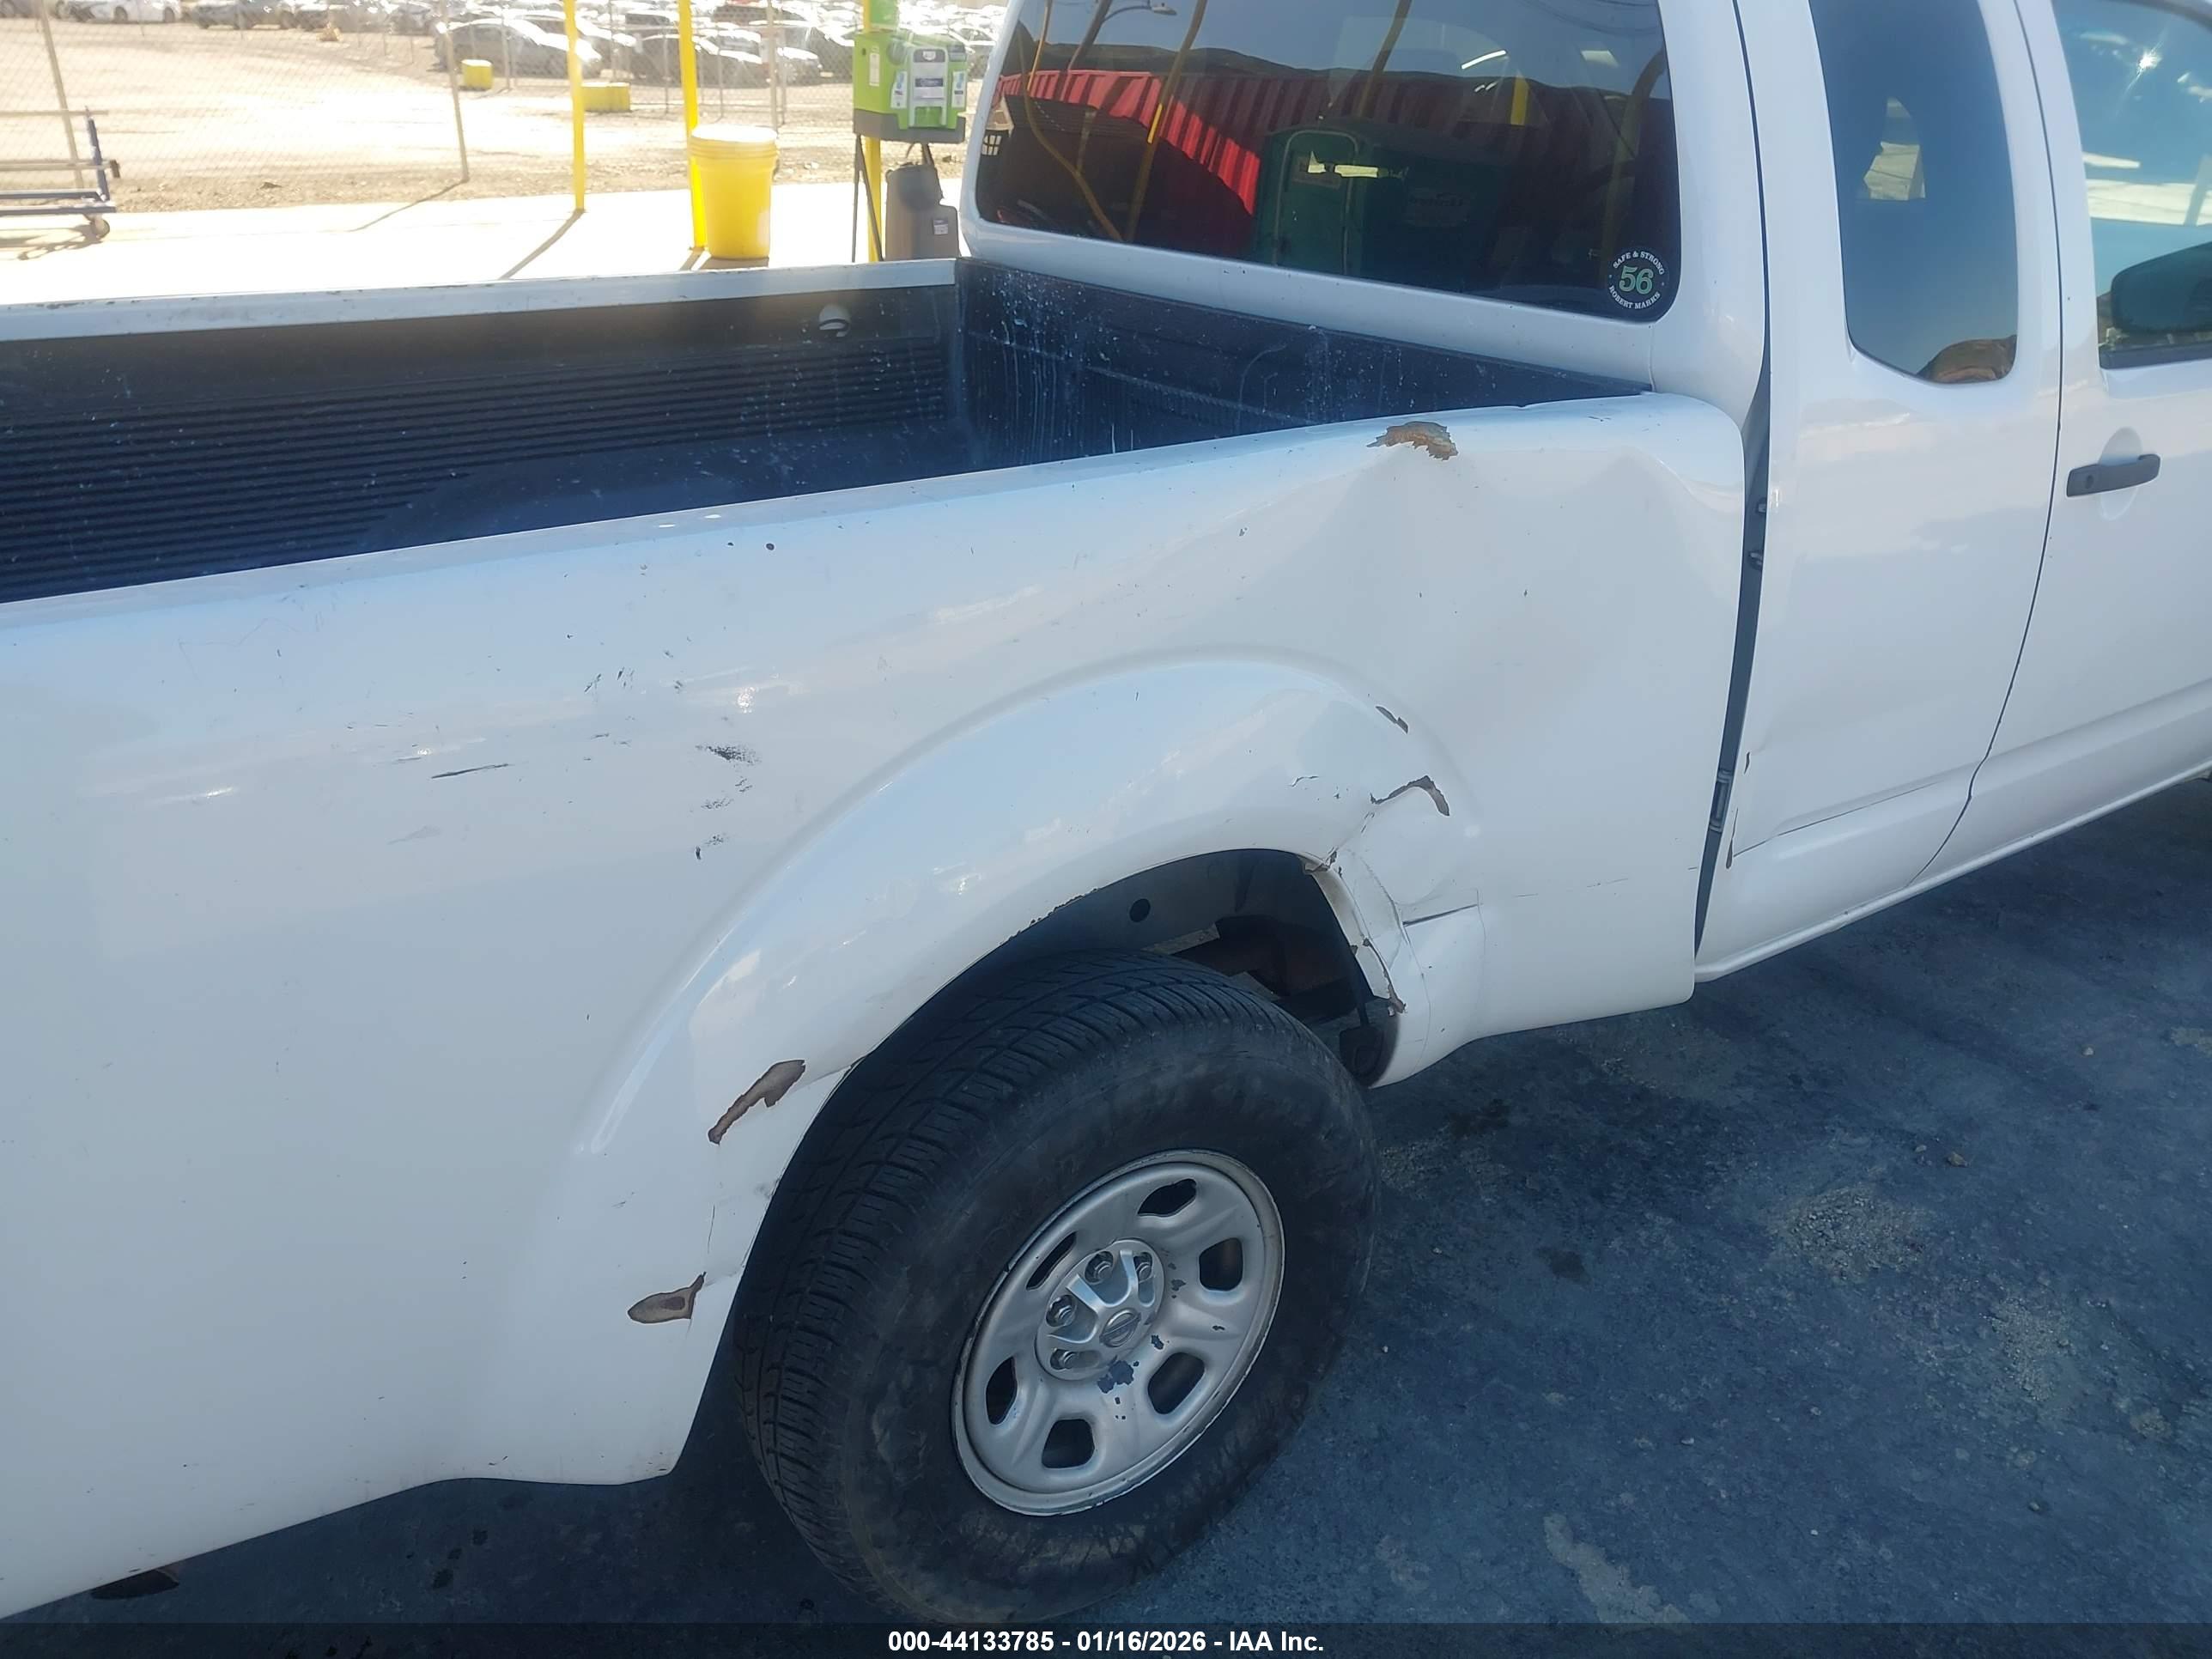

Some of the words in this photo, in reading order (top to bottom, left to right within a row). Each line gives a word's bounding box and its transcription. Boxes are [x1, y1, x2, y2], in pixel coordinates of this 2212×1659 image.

[1613, 252, 1632, 269] SAFE
[1639, 251, 1665, 275] STRONG
[1619, 265, 1654, 295] 56
[1608, 284, 1634, 309] ROBERT
[1634, 291, 1661, 310] MARKS
